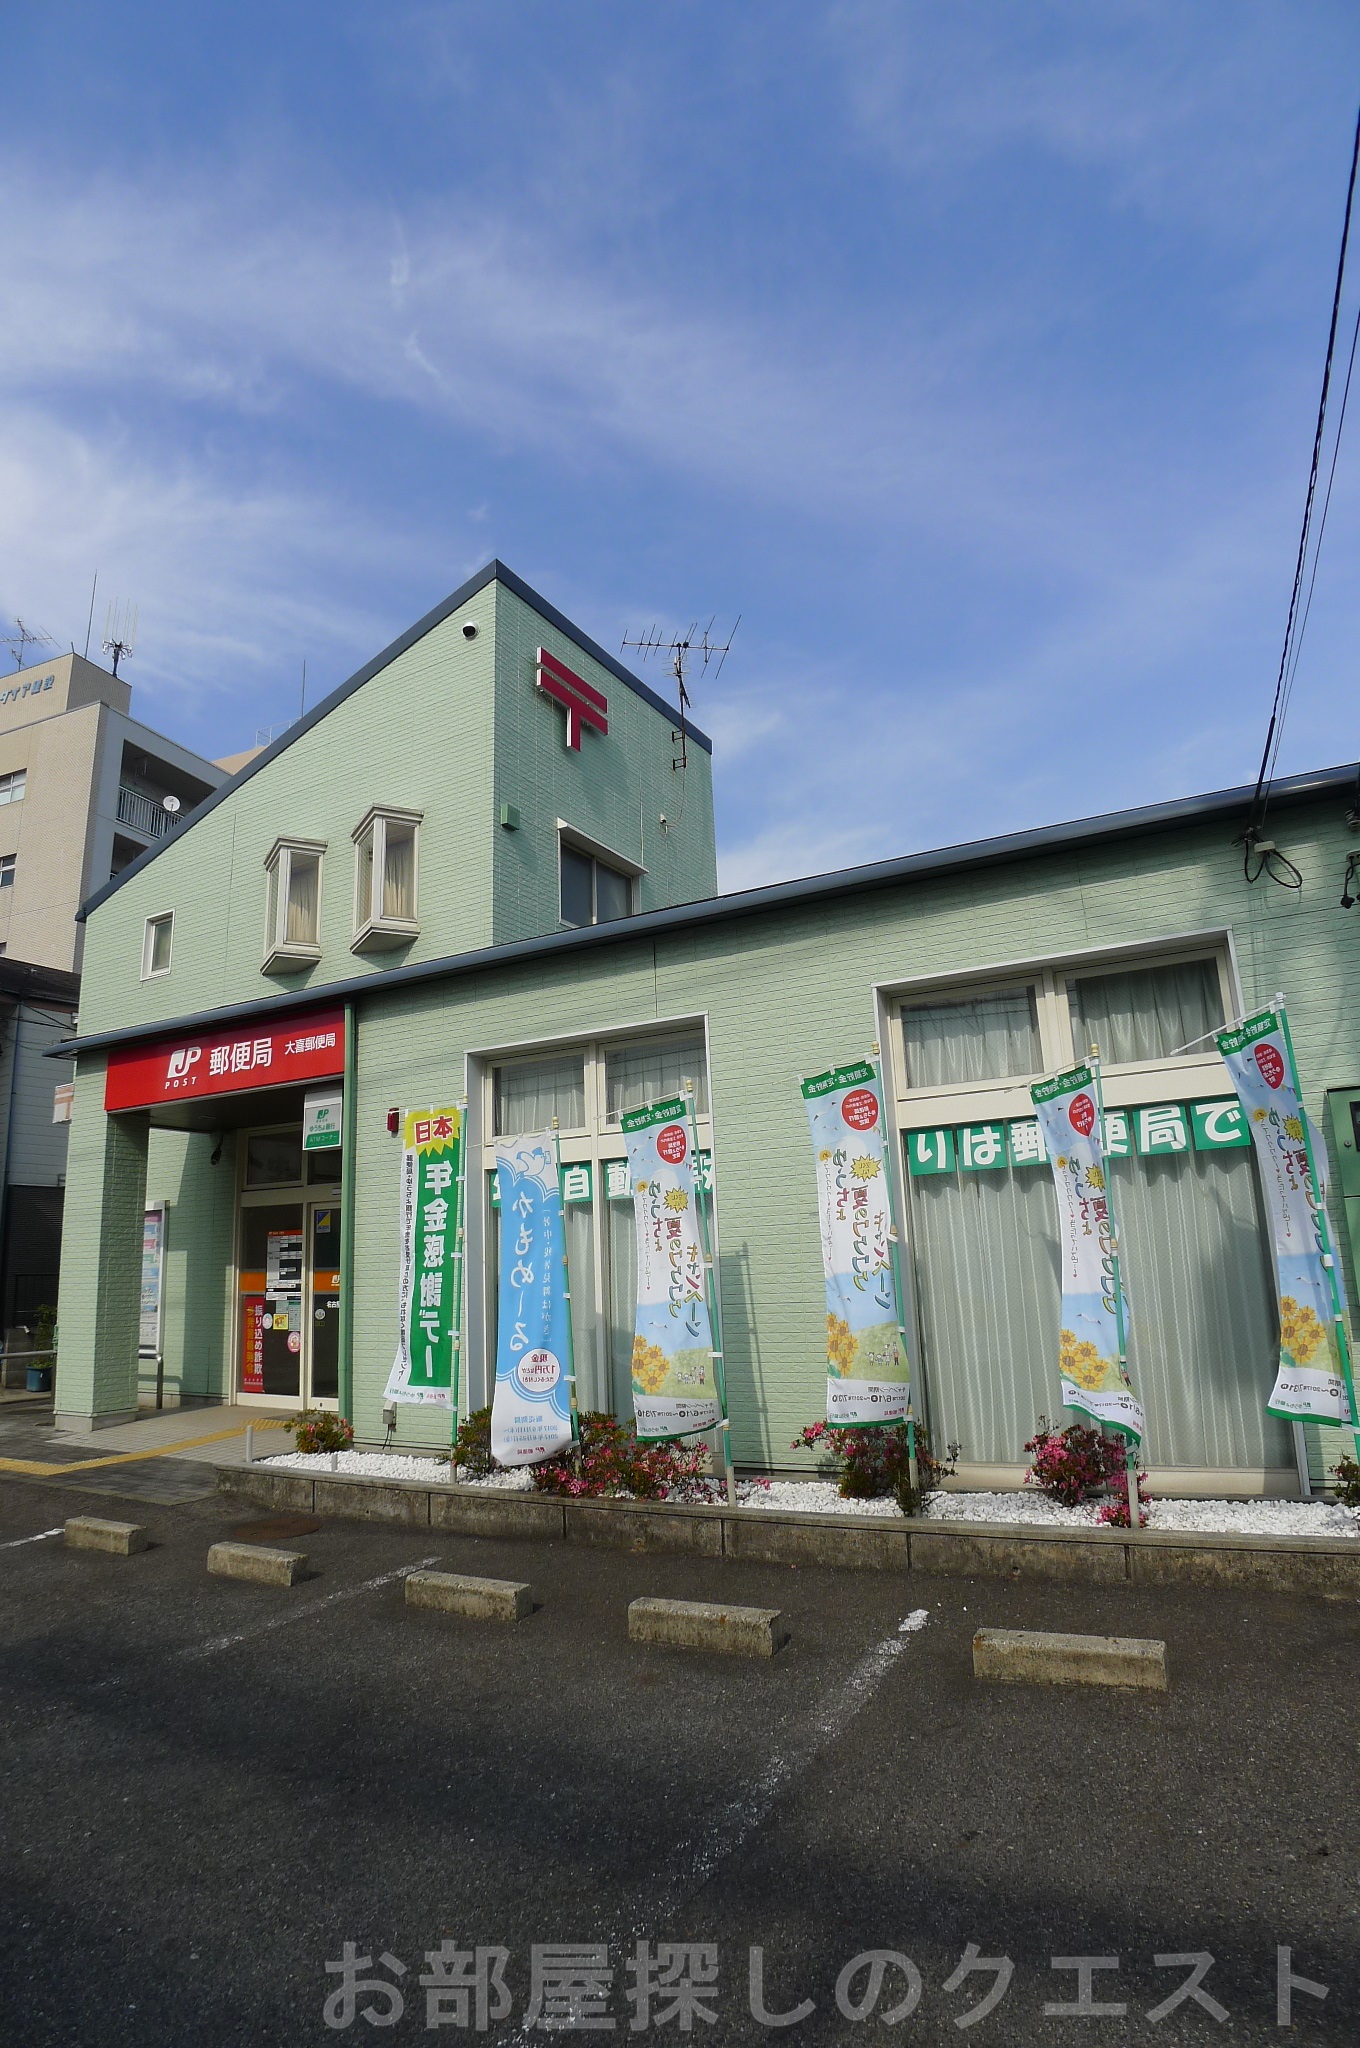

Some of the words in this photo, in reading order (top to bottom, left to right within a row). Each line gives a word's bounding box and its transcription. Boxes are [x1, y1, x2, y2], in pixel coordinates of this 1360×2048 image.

[285, 1033, 336, 1055] 大喜郵便局
[209, 1037, 272, 1076] 郵便局
[165, 1076, 198, 1089] POST
